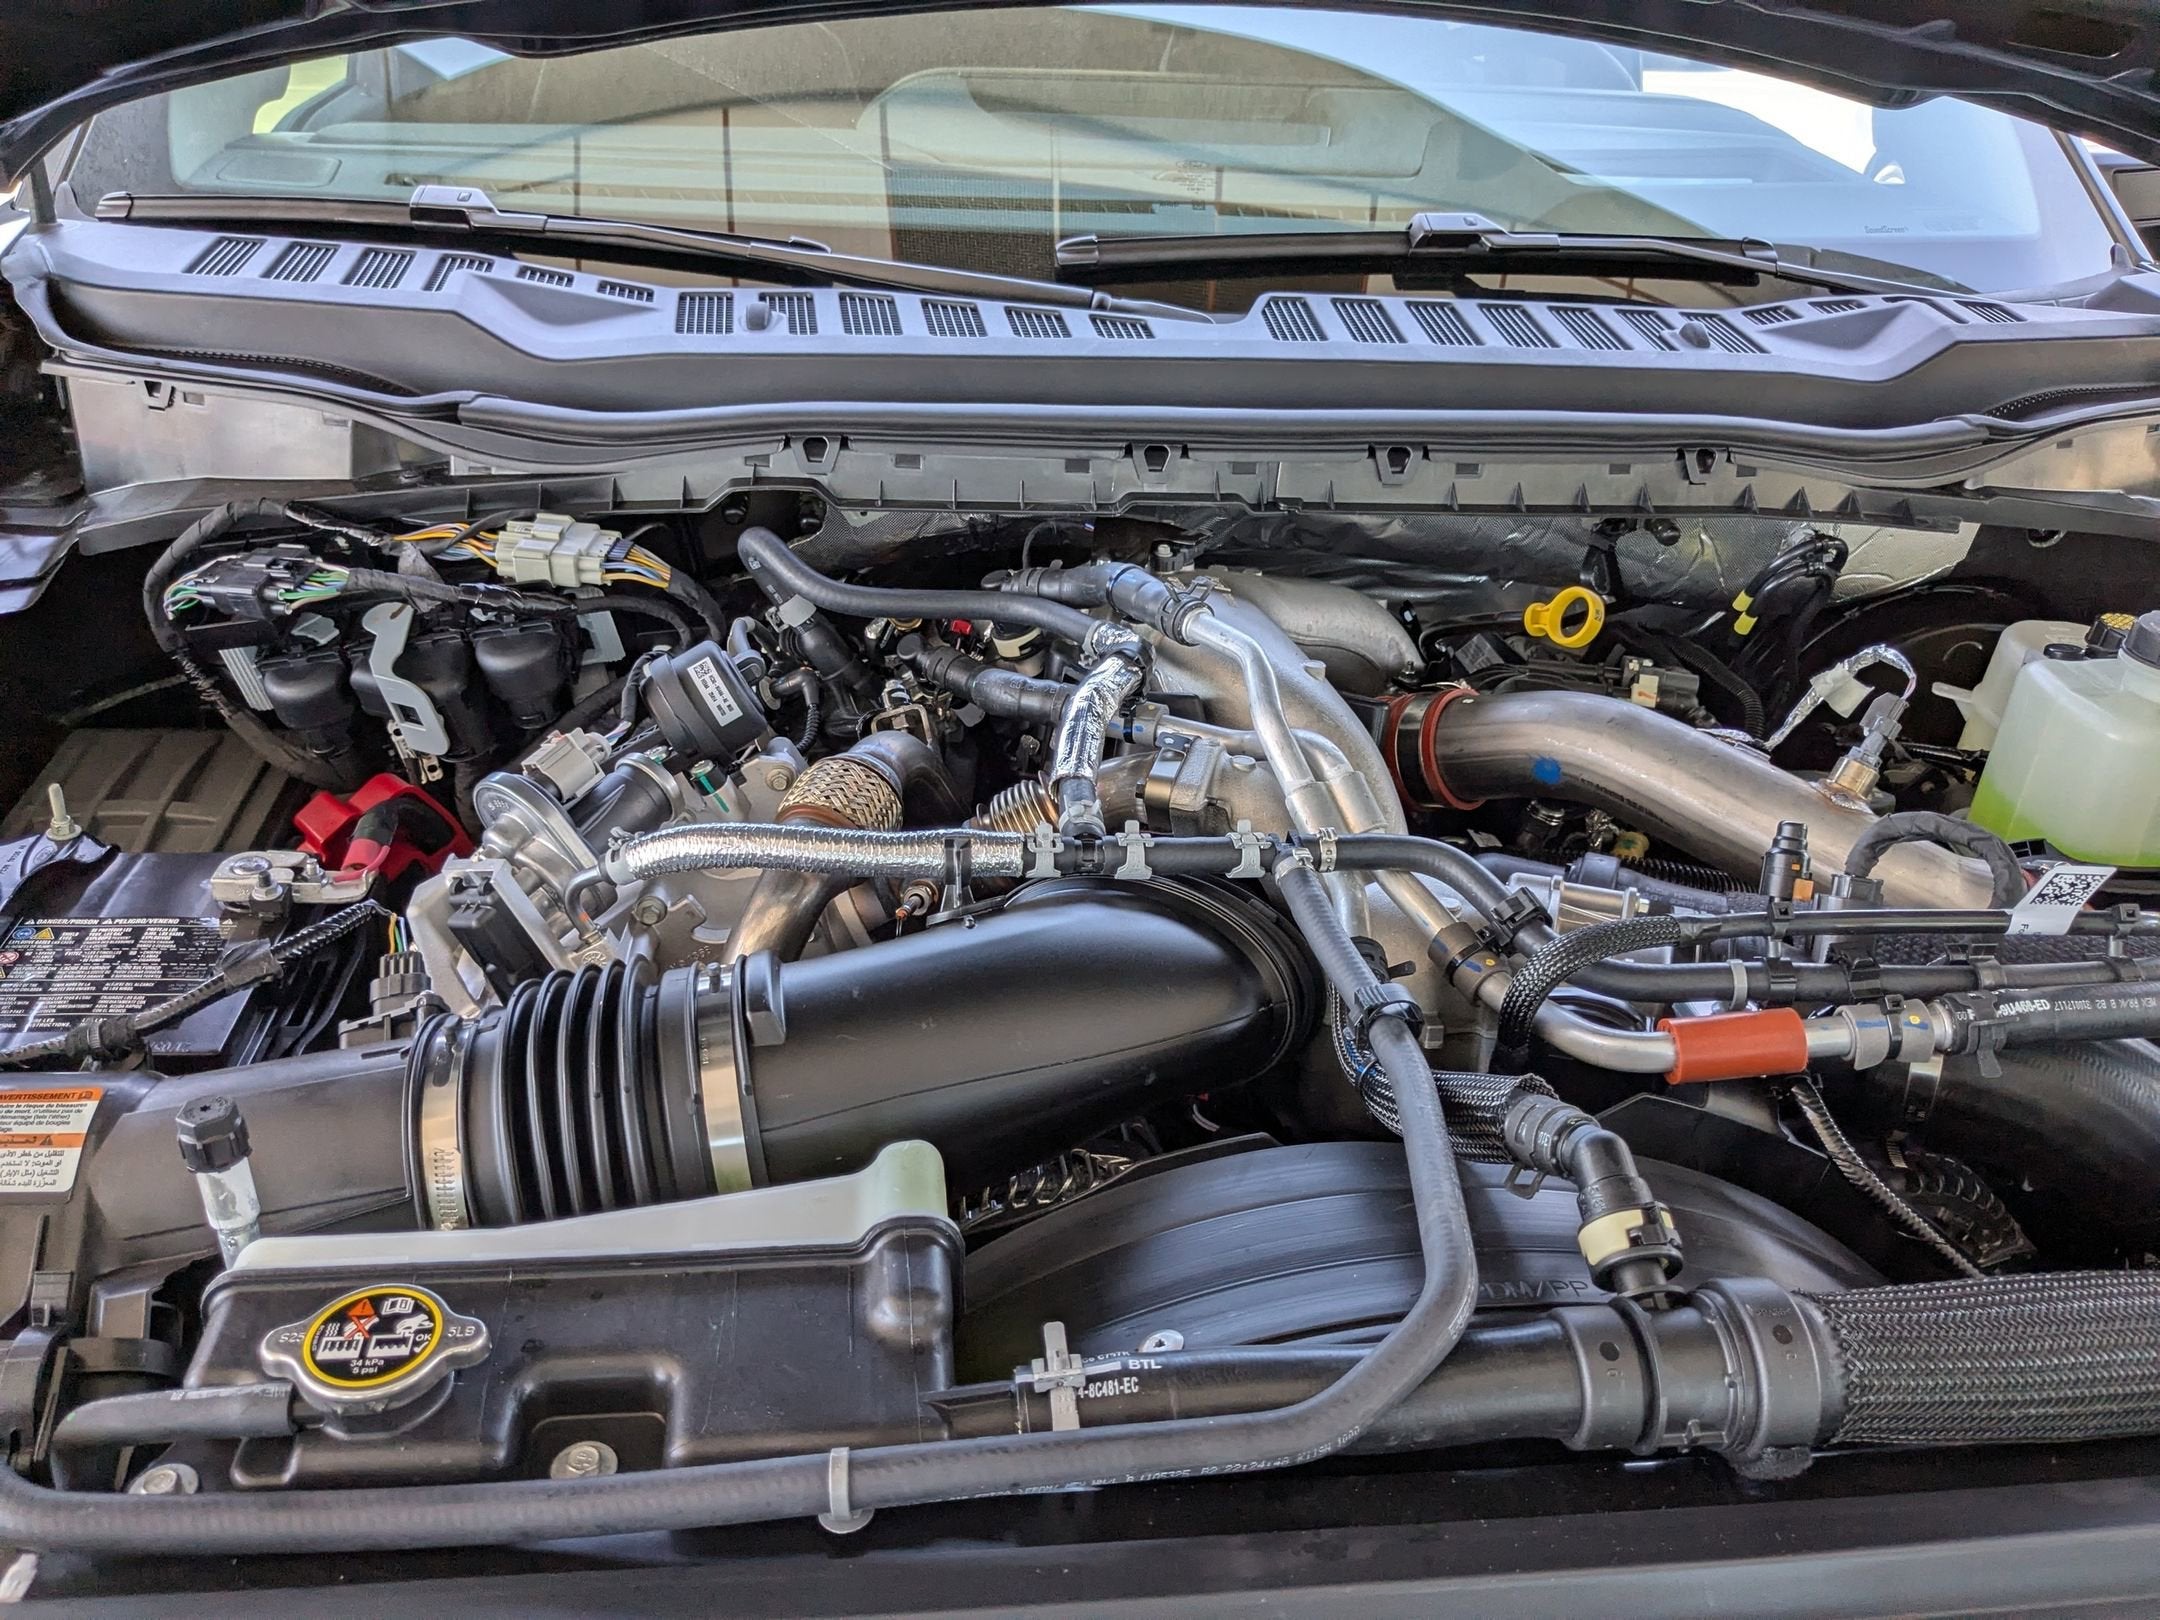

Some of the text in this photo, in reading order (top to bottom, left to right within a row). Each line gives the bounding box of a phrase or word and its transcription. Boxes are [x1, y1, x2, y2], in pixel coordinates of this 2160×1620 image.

[415, 1333, 432, 1342] OK
[350, 1358, 385, 1367] 34 kPa
[1128, 1359, 1163, 1370] BTL
[352, 1366, 379, 1376] 5 psi
